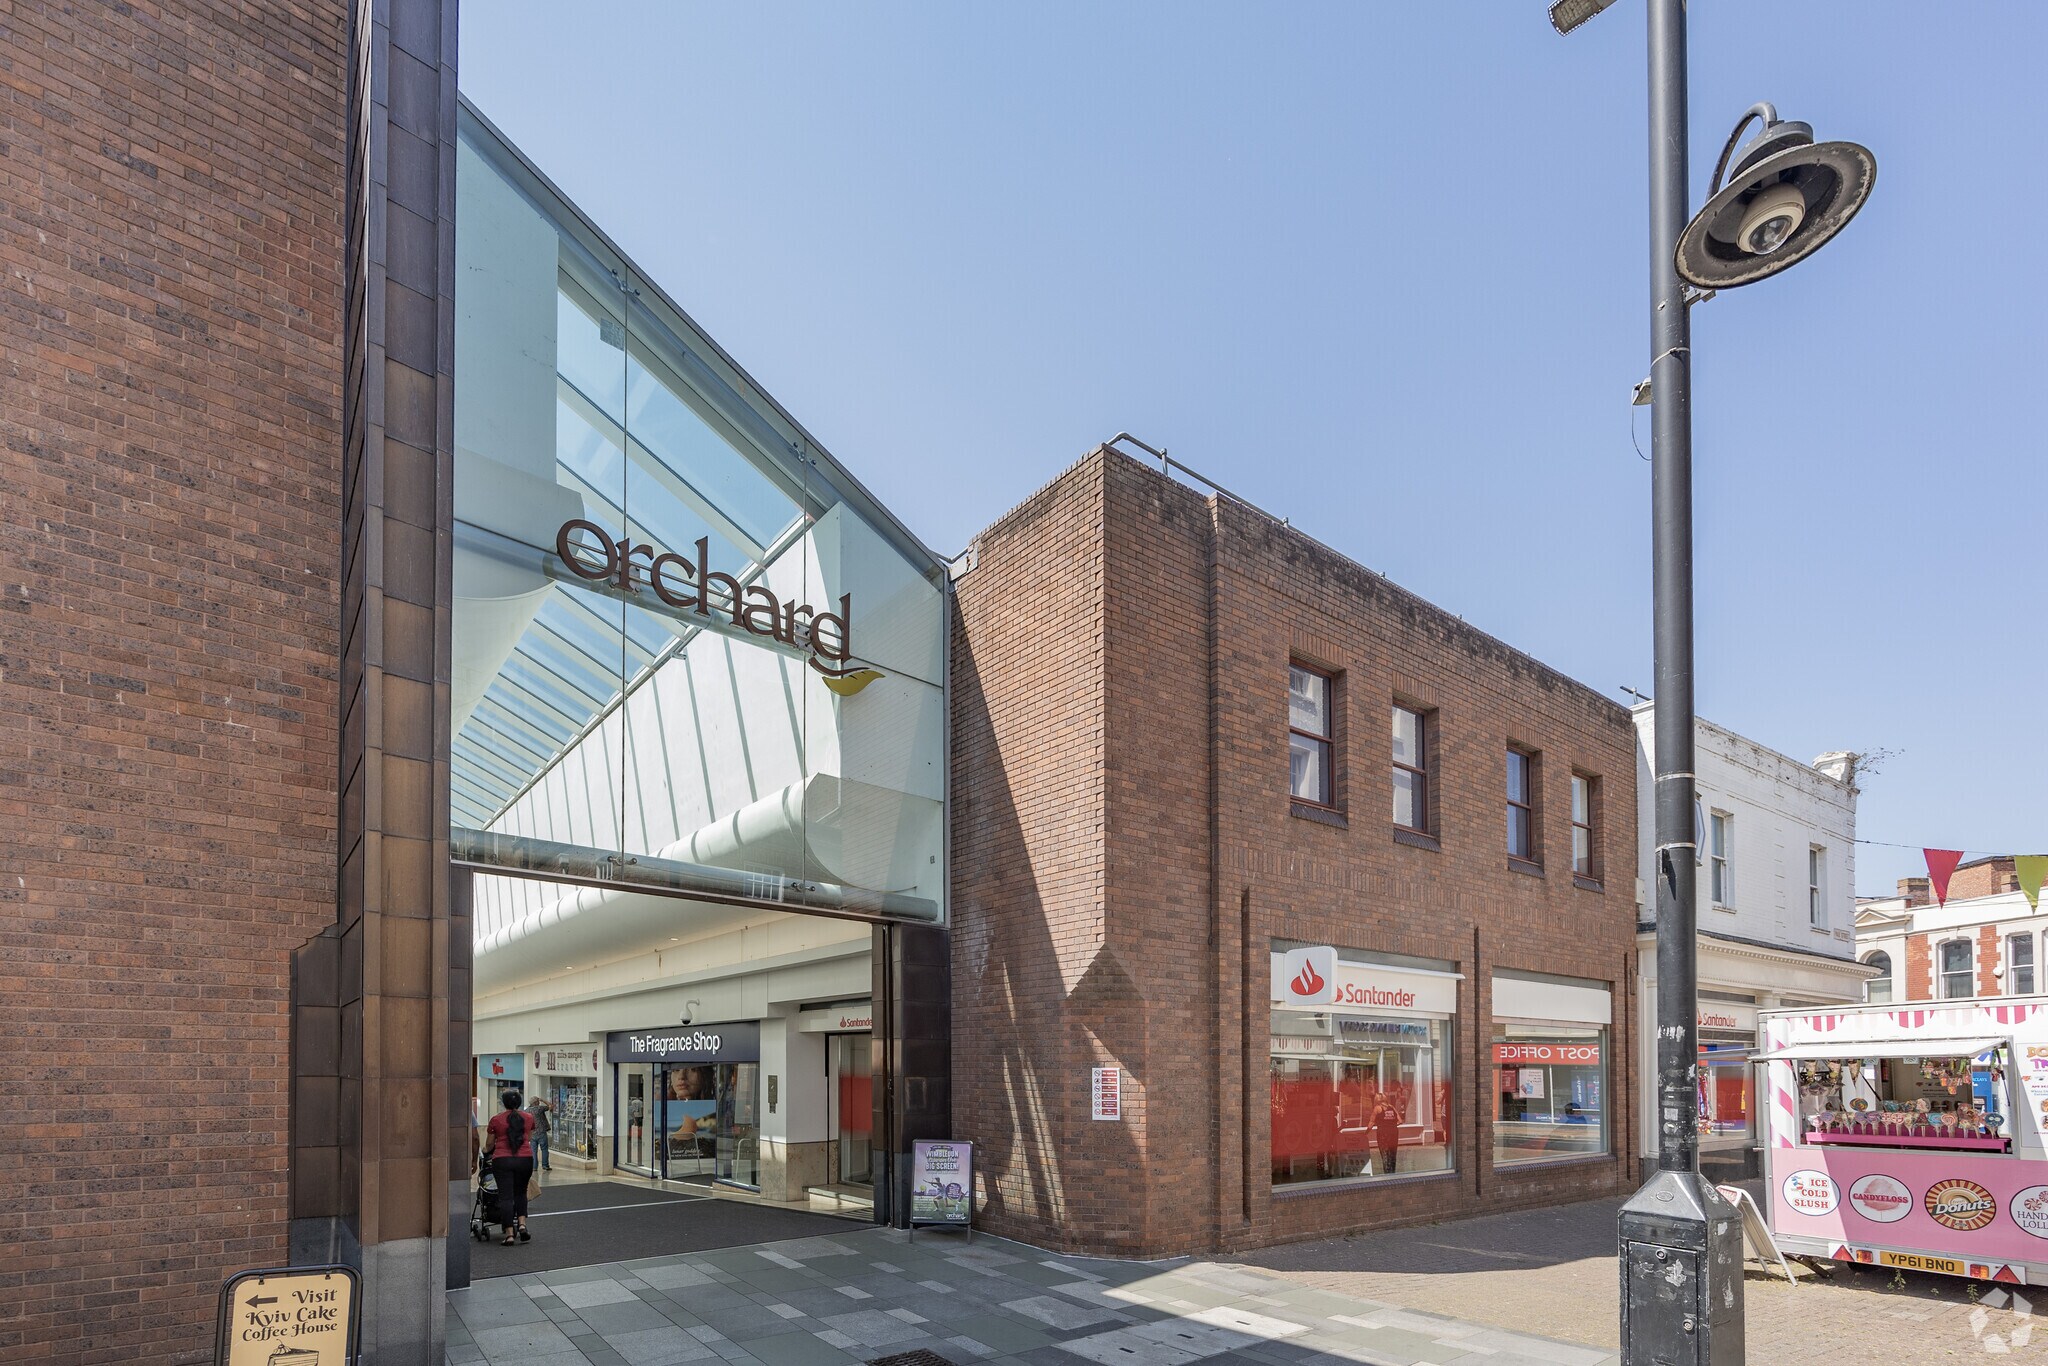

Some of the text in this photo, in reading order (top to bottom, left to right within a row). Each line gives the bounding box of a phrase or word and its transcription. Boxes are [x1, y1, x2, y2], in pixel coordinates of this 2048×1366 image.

[556, 518, 851, 665] orchard
[1345, 983, 1416, 1007] Santander
[846, 1017, 872, 1027] Santande
[1703, 1012, 1737, 1028] Santander
[629, 1031, 721, 1057] The Fragrance Shop
[925, 1150, 959, 1158] WIMBLEDON
[925, 1162, 935, 1170] BIG
[1810, 1179, 1828, 1187] ICE
[1801, 1189, 1829, 1198] COLD
[1852, 1193, 1909, 1203] CANDYFLOSS
[1794, 1199, 1829, 1209] SLUSH
[1933, 1199, 1992, 1215] Donuts
[1889, 1253, 1955, 1272] YP61 BNO
[291, 1289, 338, 1304] Visit
[245, 1306, 338, 1328] Kyiv Cake
[242, 1322, 338, 1342] Coffee House
